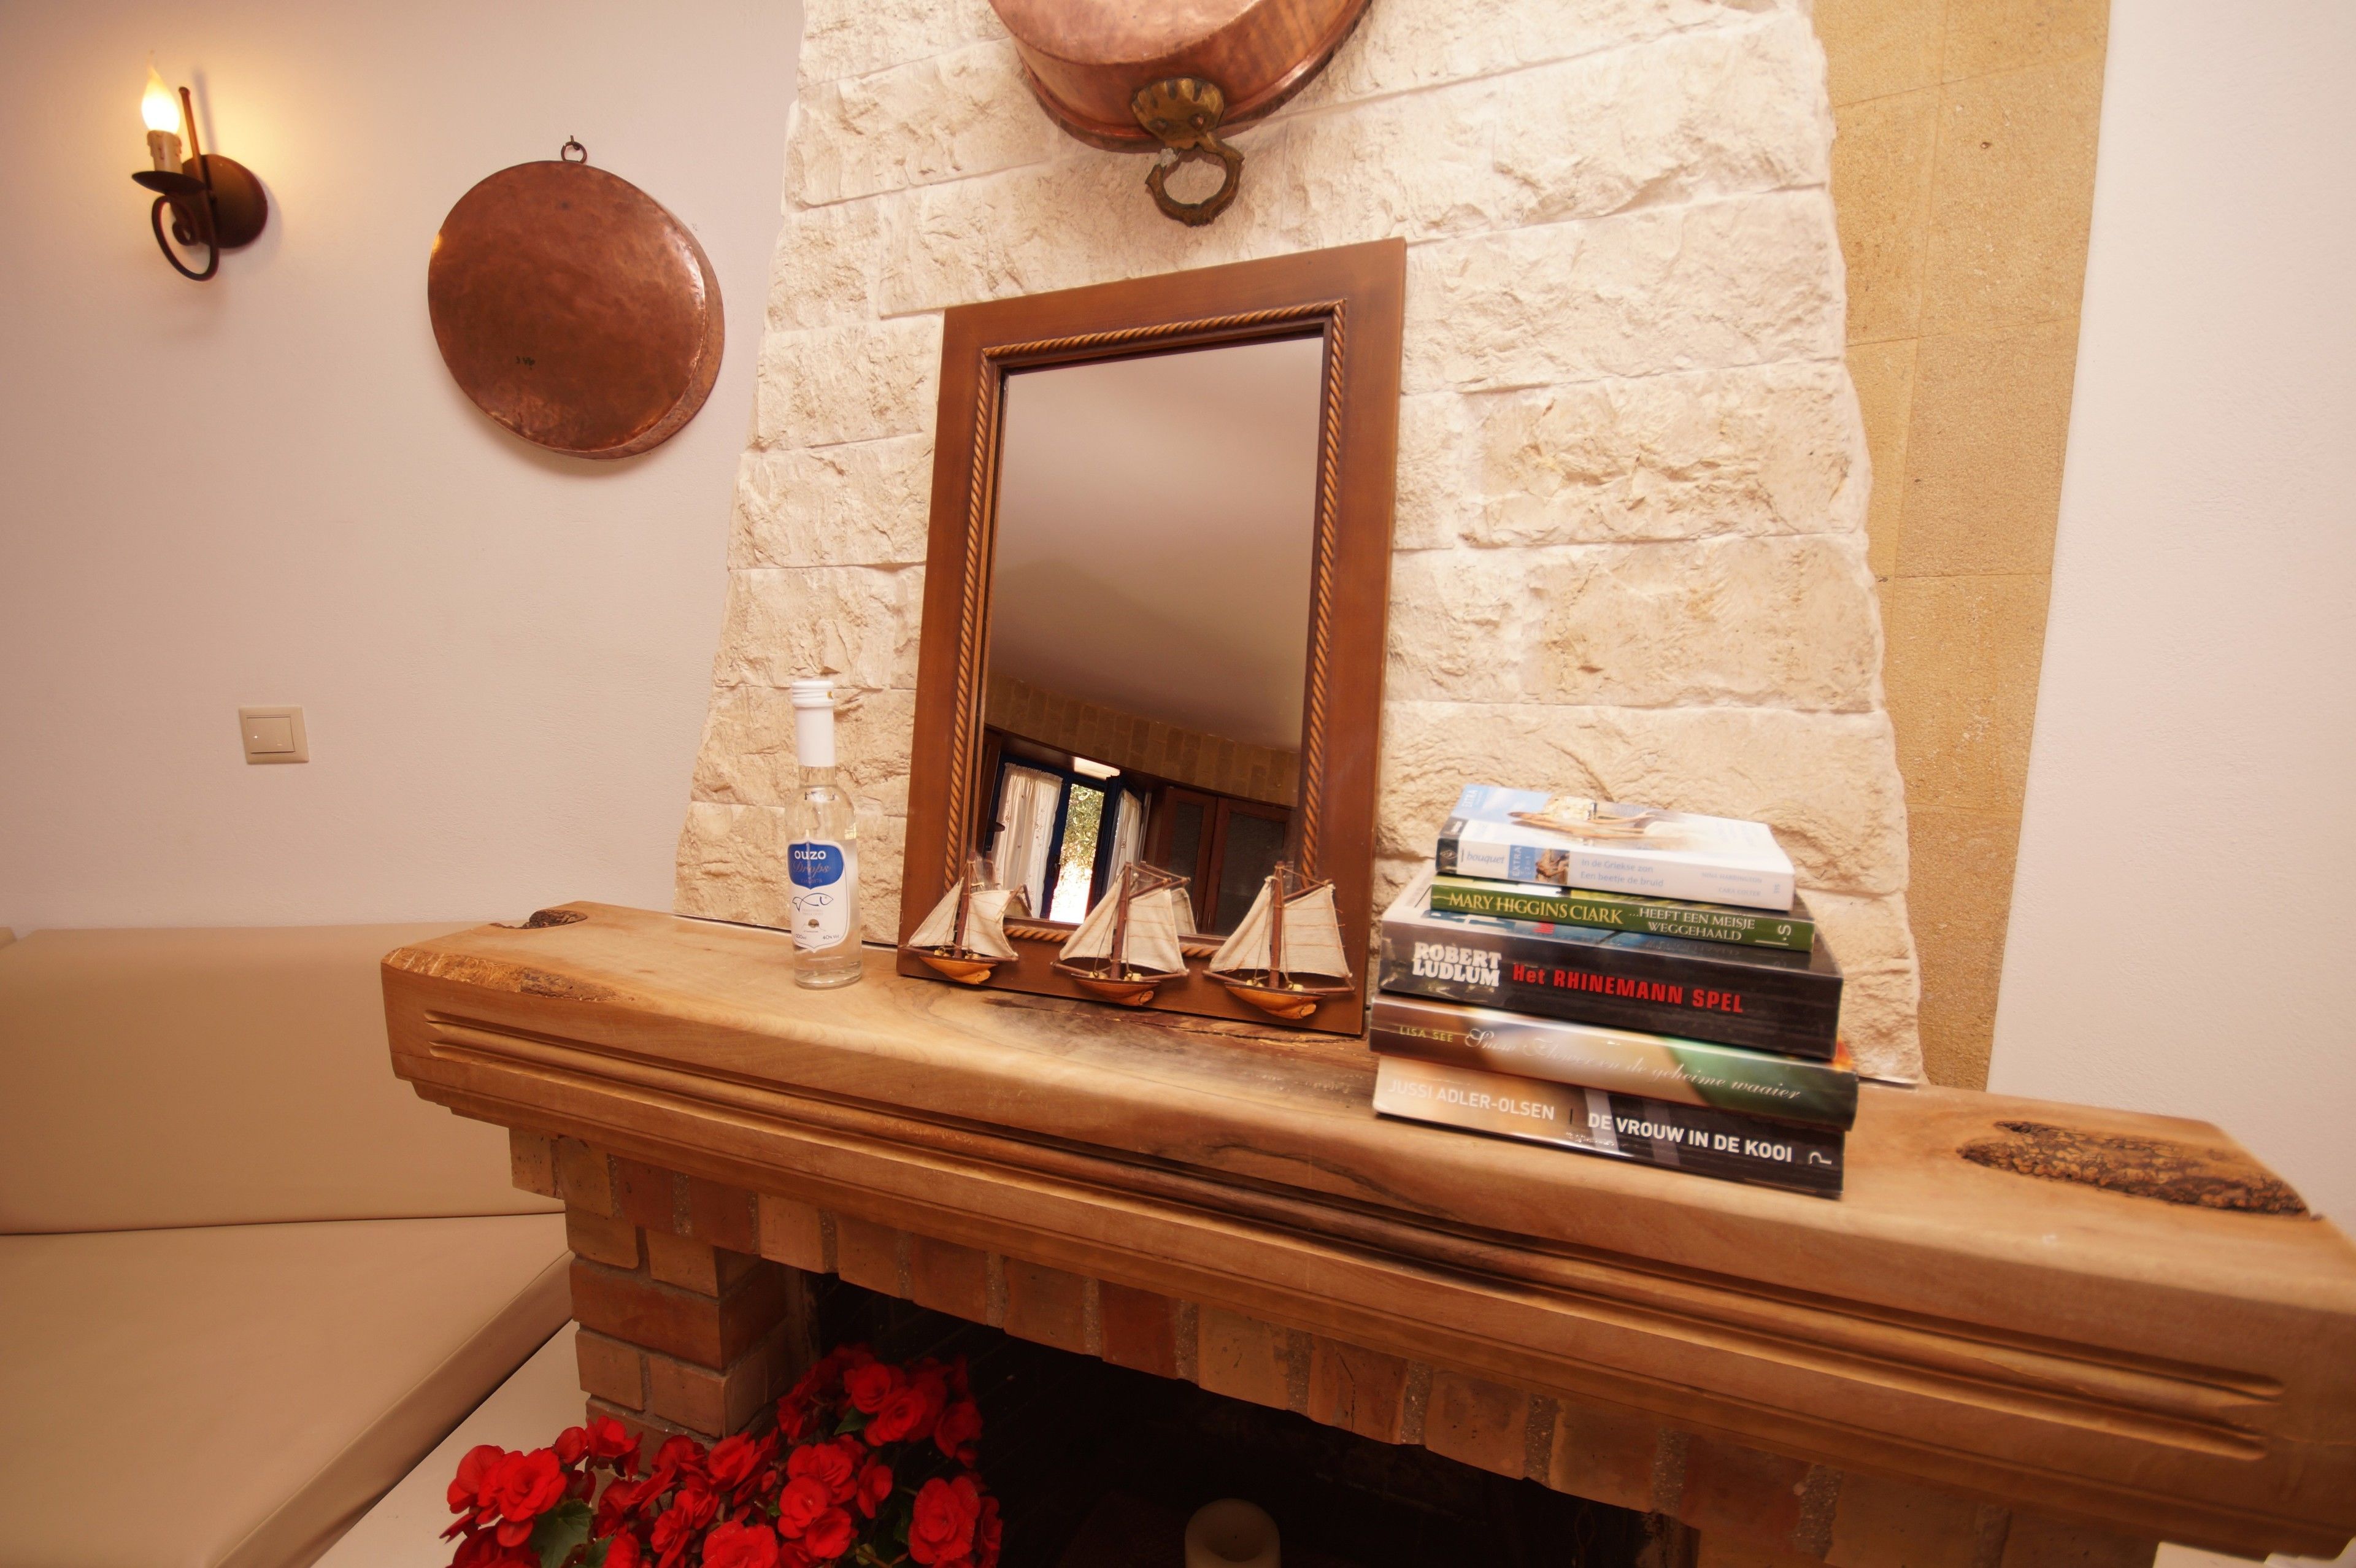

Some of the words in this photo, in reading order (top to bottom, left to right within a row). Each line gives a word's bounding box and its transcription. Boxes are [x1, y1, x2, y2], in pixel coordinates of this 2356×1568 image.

[794, 850, 826, 859] ouzo
[1467, 849, 1505, 864] bouquet
[1512, 846, 1522, 876] EXTRA
[1581, 859, 1590, 867] In
[1591, 859, 1602, 868] de
[1604, 860, 1636, 871] Griekse
[1580, 871, 1596, 880] Een
[1598, 873, 1625, 884] beetje
[1628, 875, 1639, 885] de
[1640, 877, 1664, 887] bruid
[1449, 893, 1493, 910] MARY
[1496, 896, 1568, 918] HIGGINS
[1569, 905, 1625, 924] CLARK
[1684, 912, 1709, 924] EEN
[1712, 915, 1755, 931] MEISJE
[1647, 921, 1742, 941] WEGGEHAALD
[1415, 942, 1502, 969] ROBERT
[1412, 958, 1500, 987] LUDLUM
[1512, 963, 1546, 985] Het
[1553, 969, 1683, 1004] RHINEMANN
[1692, 988, 1743, 1013] SPEL
[1399, 1026, 1426, 1039] LISA
[1433, 1031, 1453, 1043] SEE
[1465, 1028, 1516, 1053] Snow
[1600, 1060, 1620, 1070] en
[1627, 1057, 1647, 1074] de
[1653, 1063, 1726, 1088] geheime
[1731, 1082, 1801, 1100] waaier
[1388, 1079, 1433, 1099] JUSSI
[1436, 1088, 1555, 1120] ADLER-OLSEN
[1588, 1113, 1612, 1131] DE
[1615, 1117, 1684, 1143] VROUW
[1688, 1130, 1709, 1148] IN
[1714, 1134, 1740, 1153] DE
[1745, 1139, 1792, 1163] KOOI
